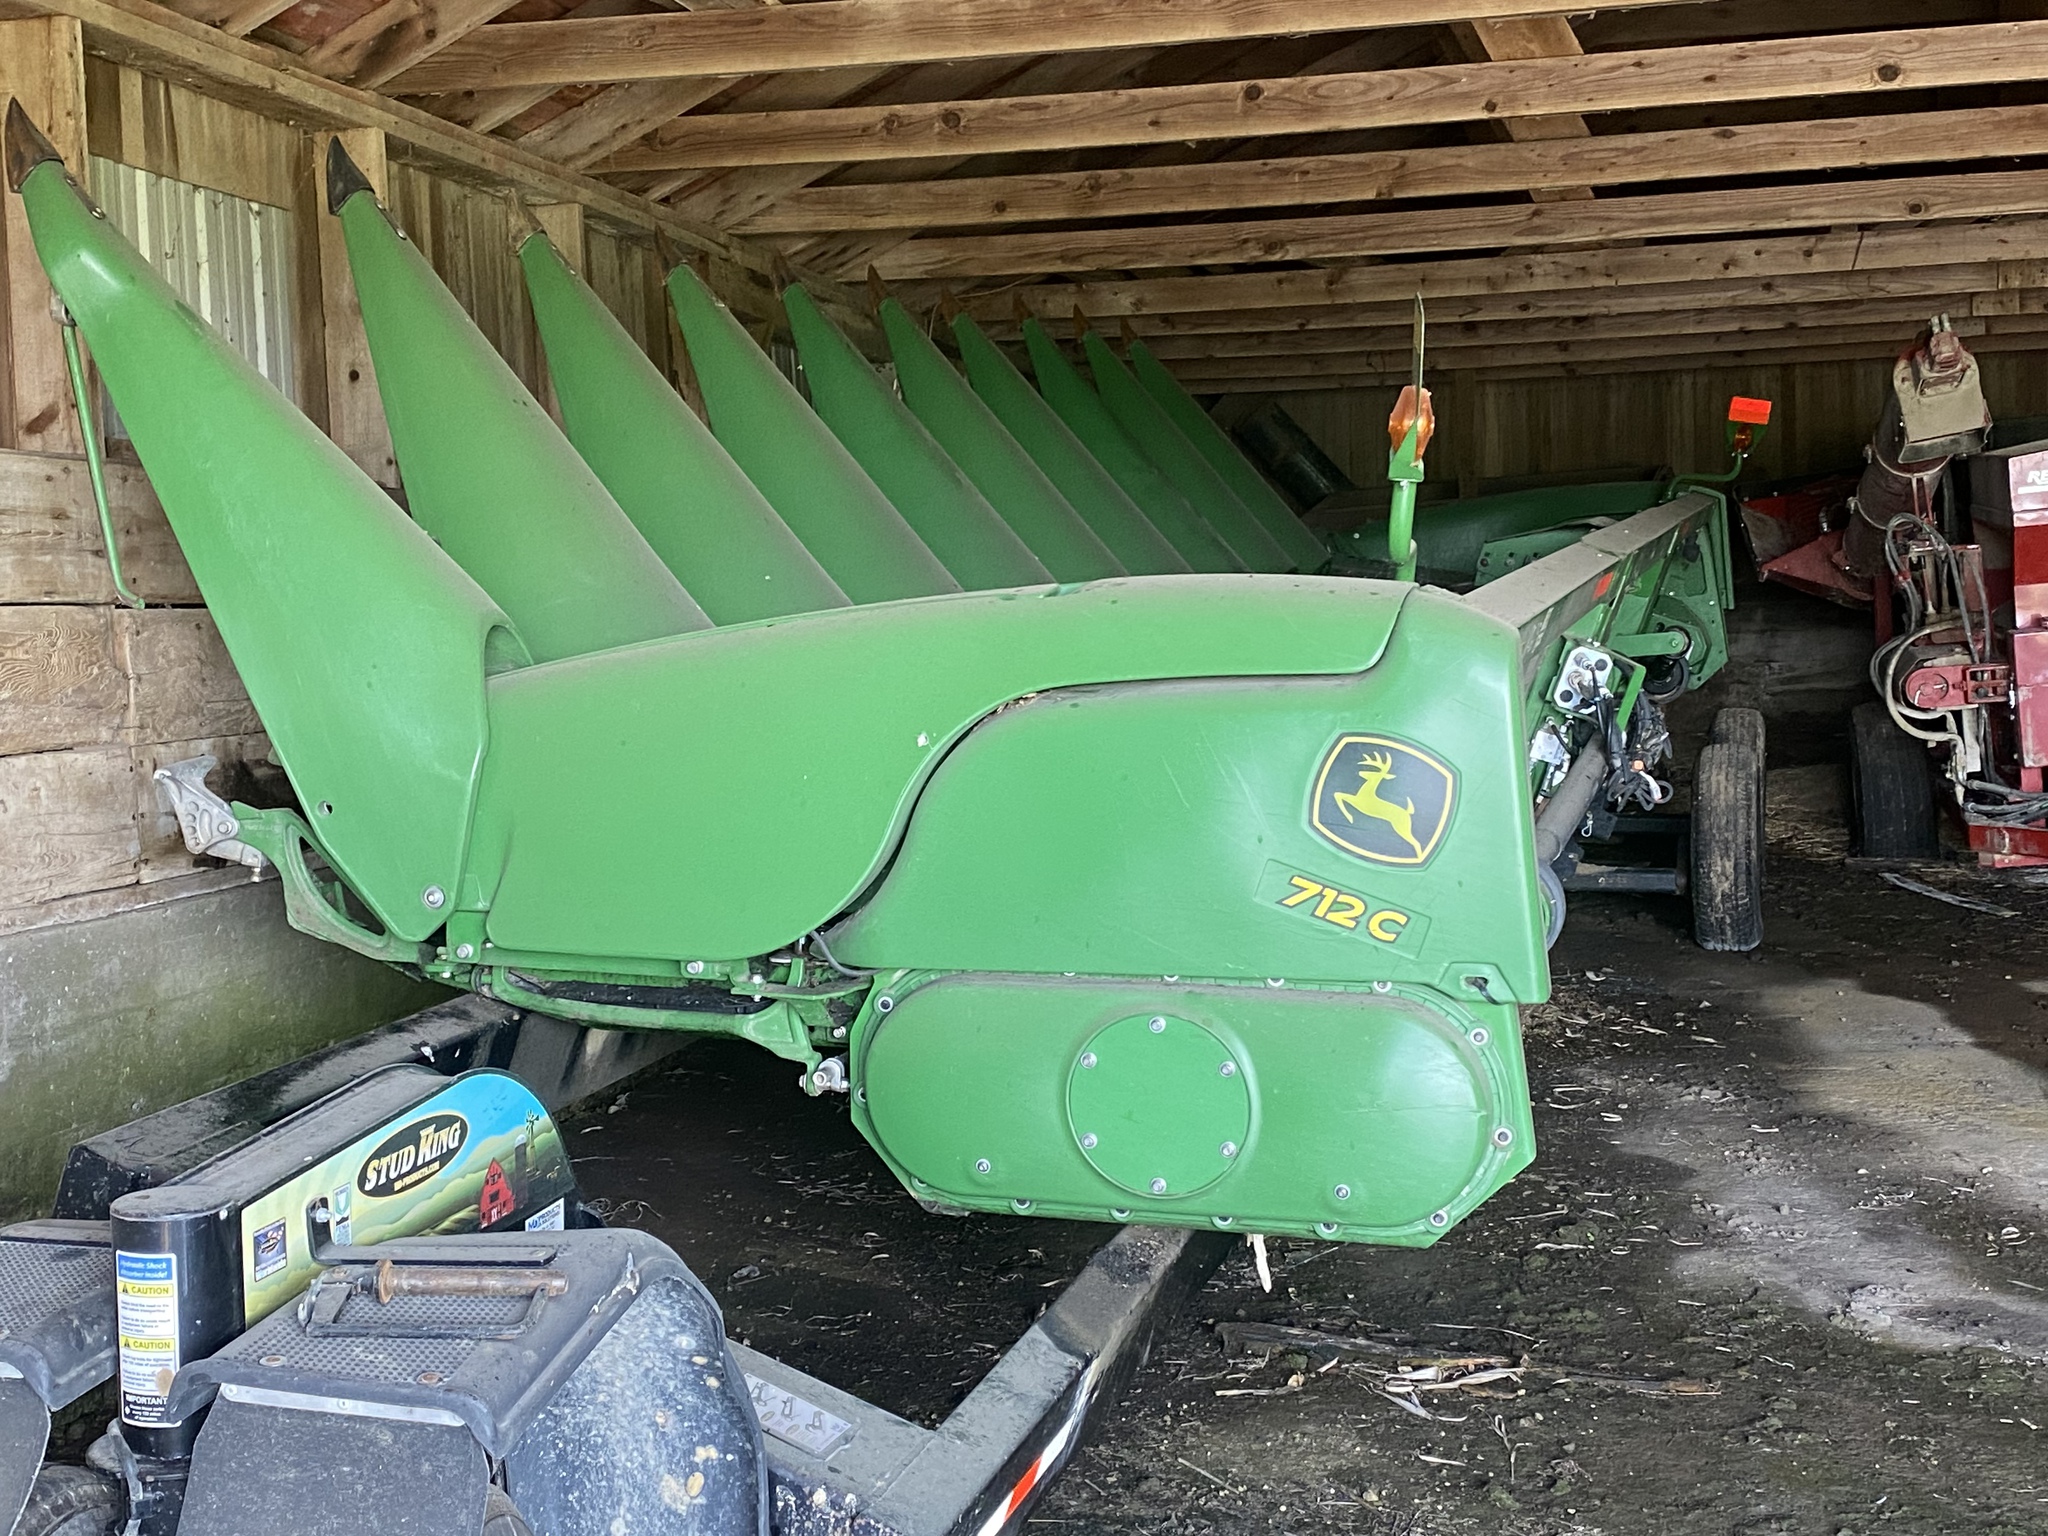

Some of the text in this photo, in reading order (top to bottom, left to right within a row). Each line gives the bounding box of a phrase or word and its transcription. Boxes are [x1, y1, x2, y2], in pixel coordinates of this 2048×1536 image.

[364, 1120, 461, 1191] STUD KING
[131, 1286, 169, 1295] CAUTION
[133, 1341, 171, 1350] CAUTION
